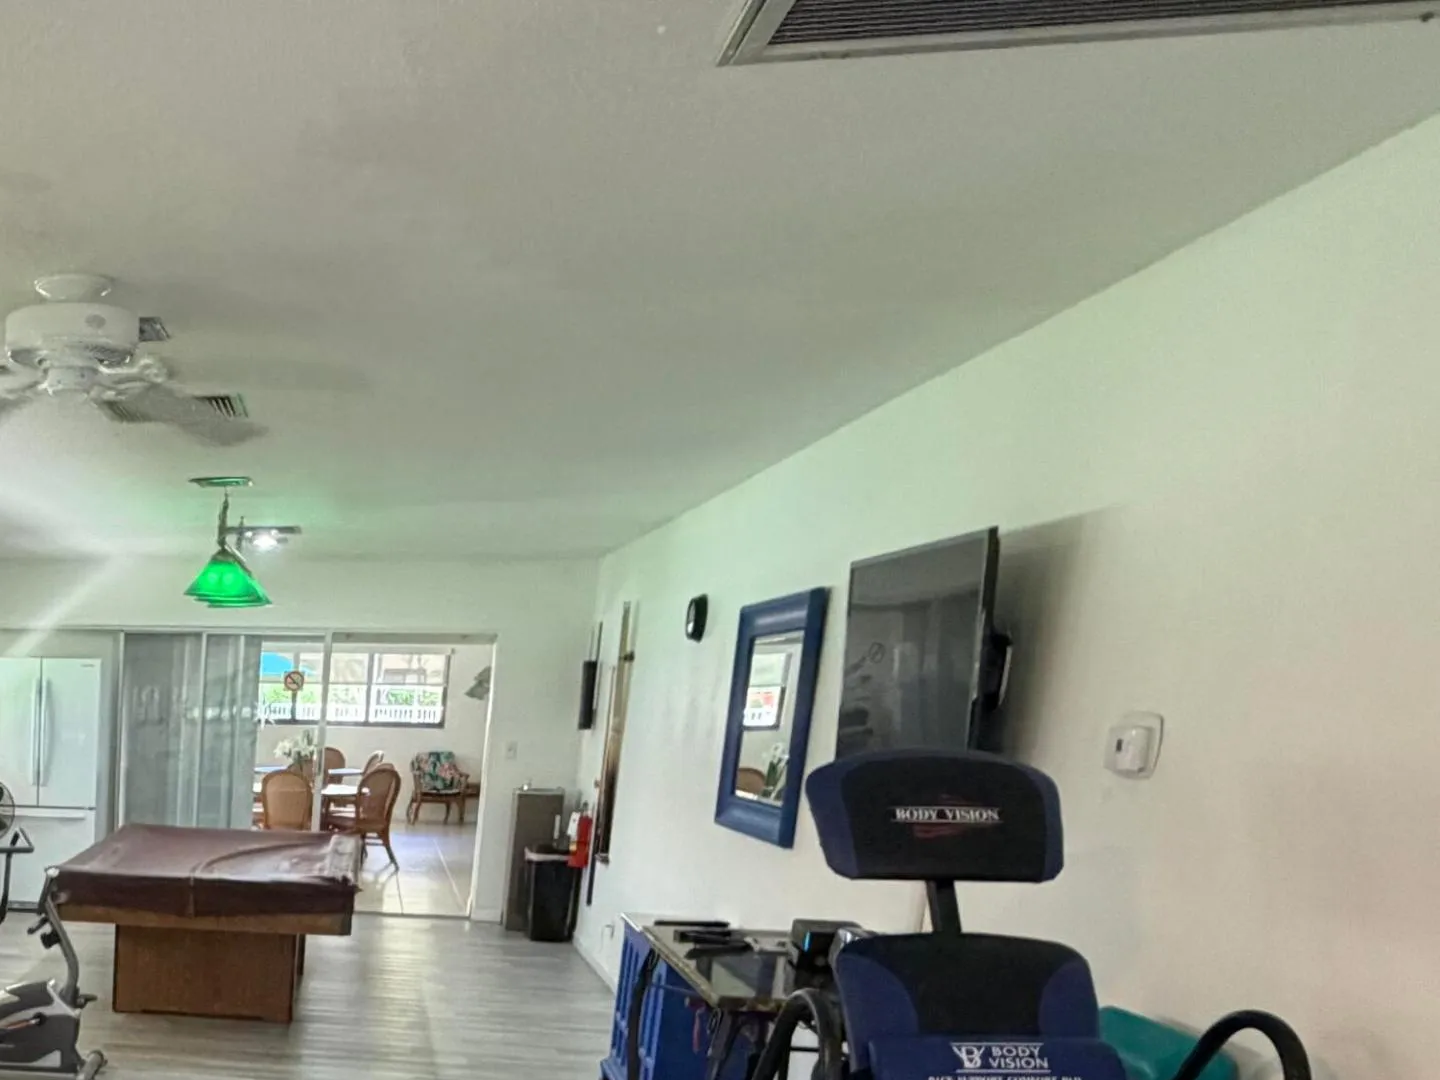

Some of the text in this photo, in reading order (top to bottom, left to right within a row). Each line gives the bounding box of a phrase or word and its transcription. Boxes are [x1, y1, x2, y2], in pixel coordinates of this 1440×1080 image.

[895, 807, 1000, 822] BODY VISION
[991, 1045, 1041, 1057] BODY
[988, 1057, 1049, 1069] VISION
